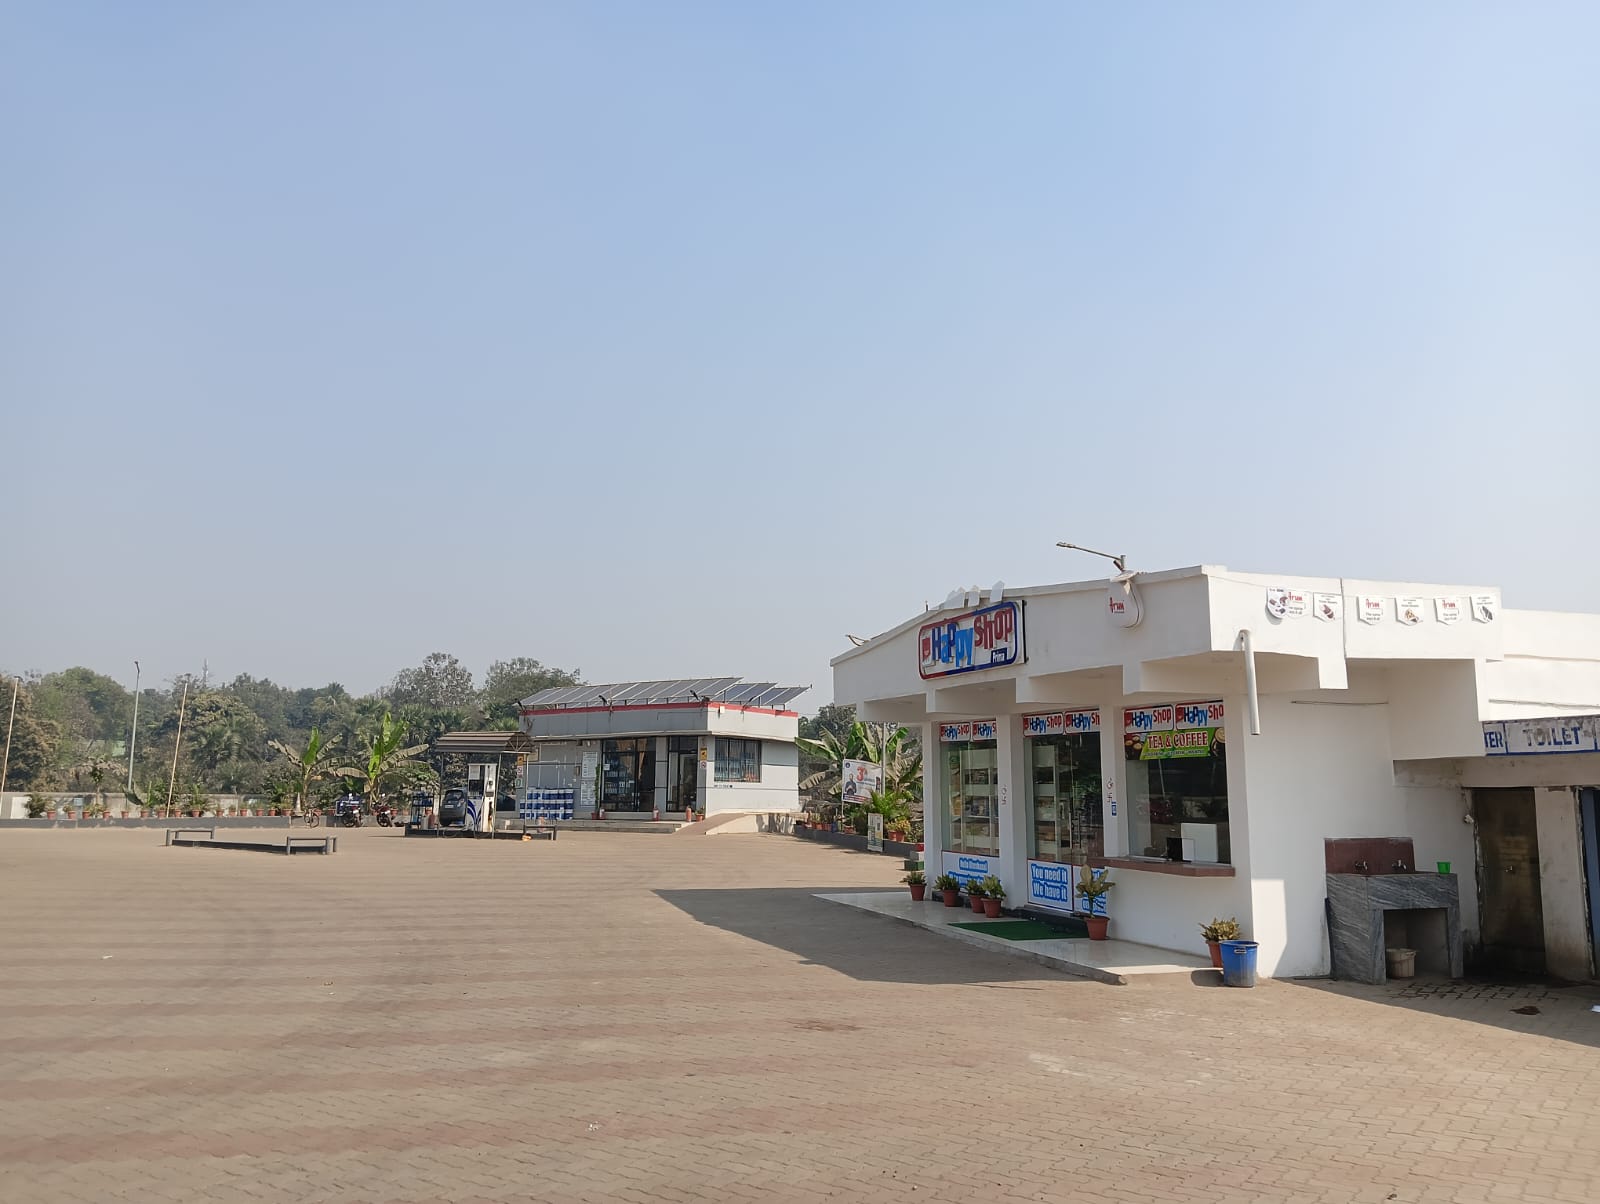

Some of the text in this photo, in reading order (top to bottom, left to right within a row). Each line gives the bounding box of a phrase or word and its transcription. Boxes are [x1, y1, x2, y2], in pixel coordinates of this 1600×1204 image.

[974, 608, 1013, 650] Shop
[1047, 715, 1062, 728] Shop
[1153, 708, 1172, 724] Shop
[1148, 732, 1208, 749] TEA & COFFEE
[1522, 726, 1581, 747] TOILET
[1031, 864, 1067, 884] You need it
[1033, 880, 1067, 901] We have it
